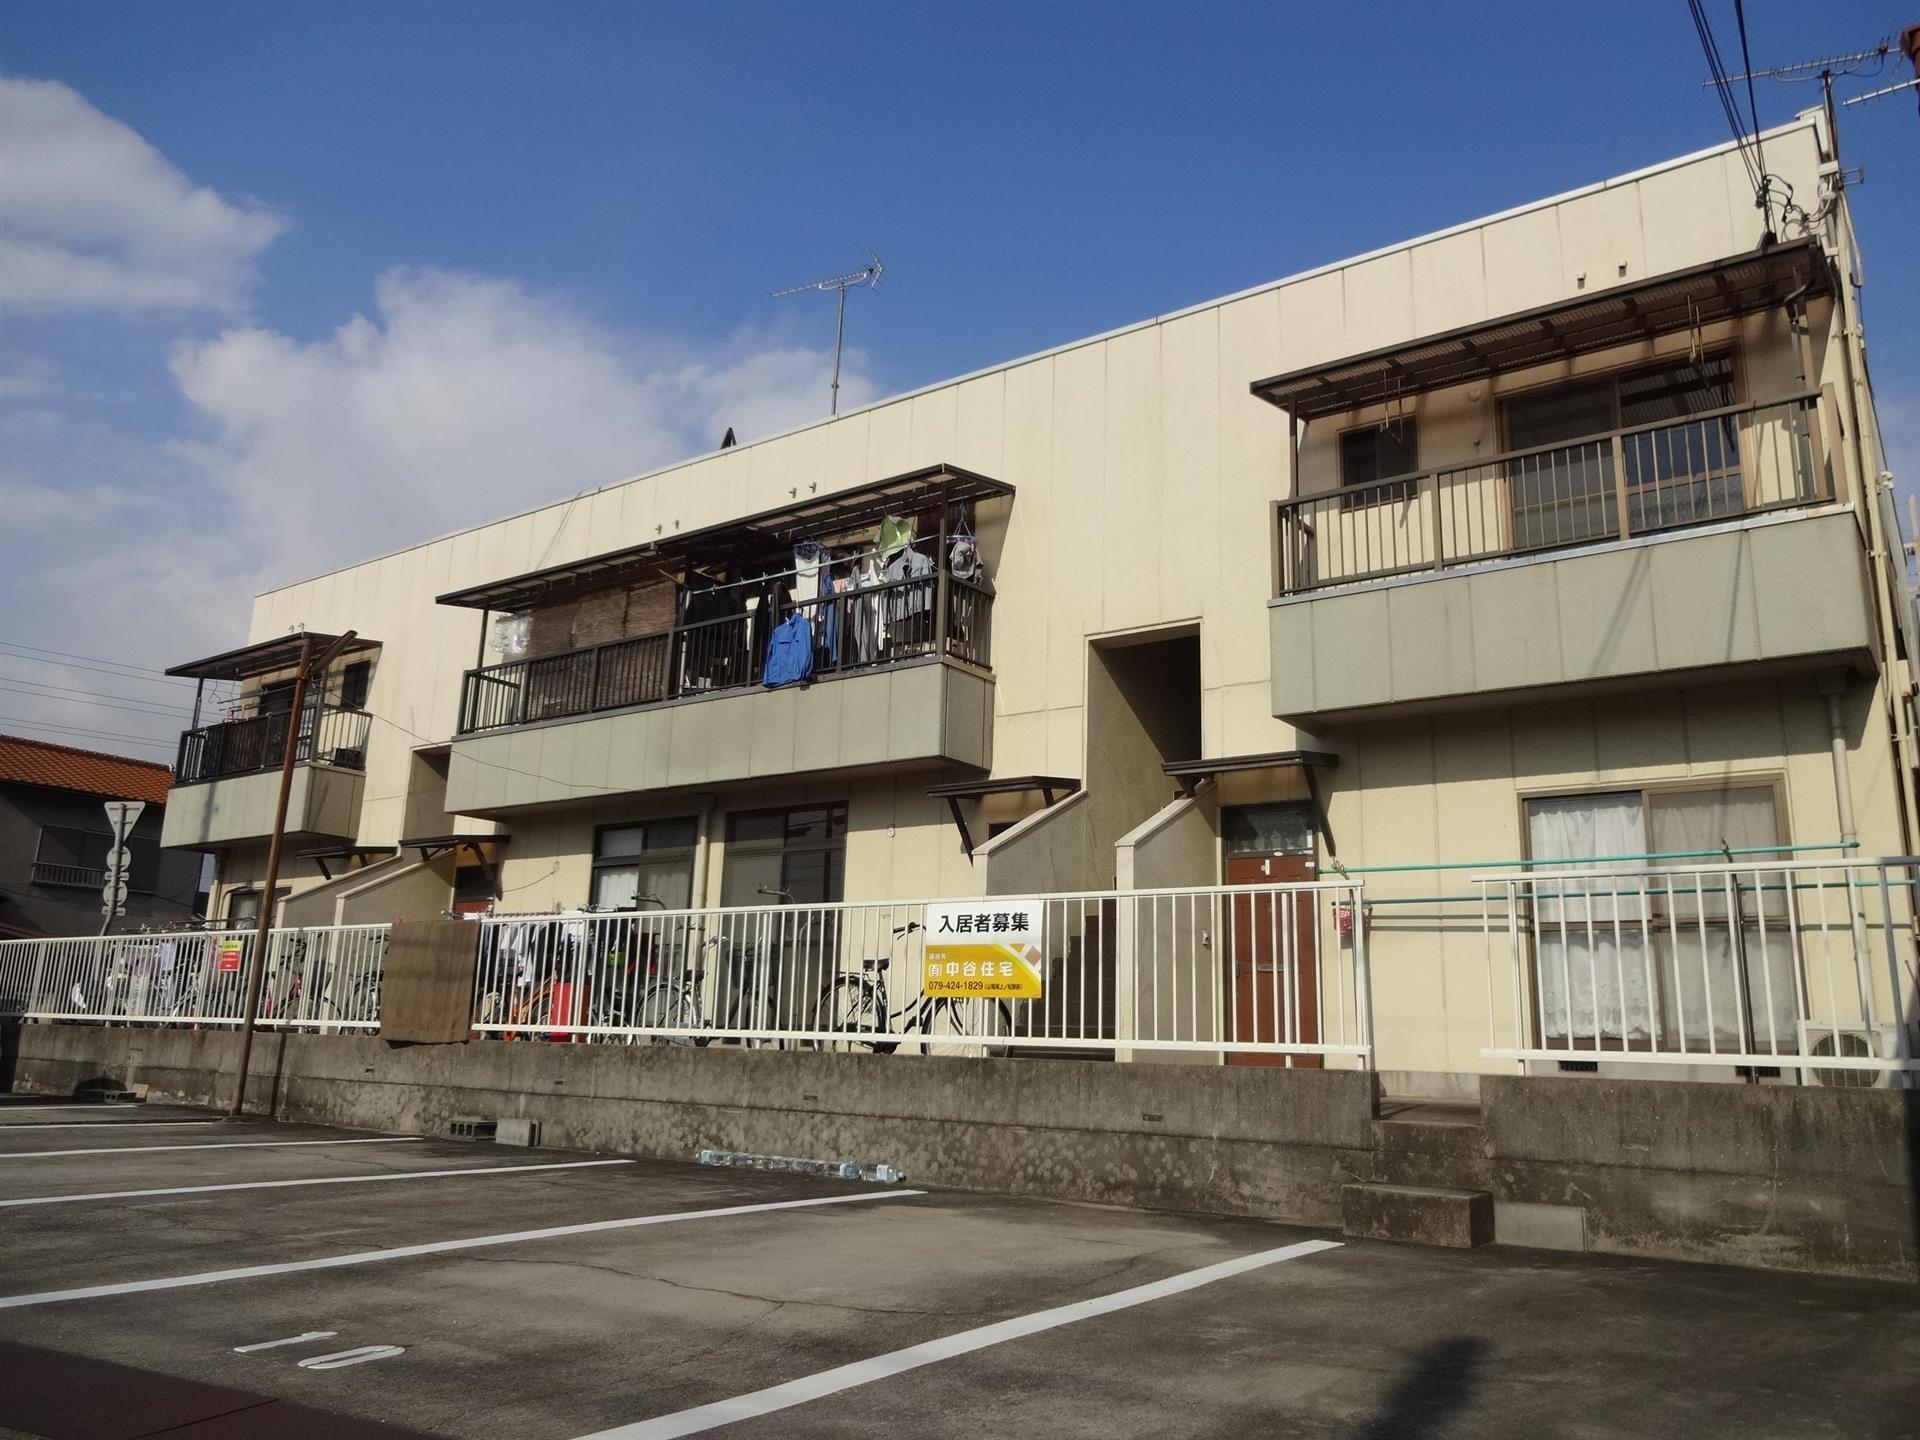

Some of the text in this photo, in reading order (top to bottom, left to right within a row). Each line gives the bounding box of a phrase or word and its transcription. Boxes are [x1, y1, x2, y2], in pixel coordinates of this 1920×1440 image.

[938, 912, 1029, 933] 入居者募集
[928, 981, 983, 990] 079-424-1829
